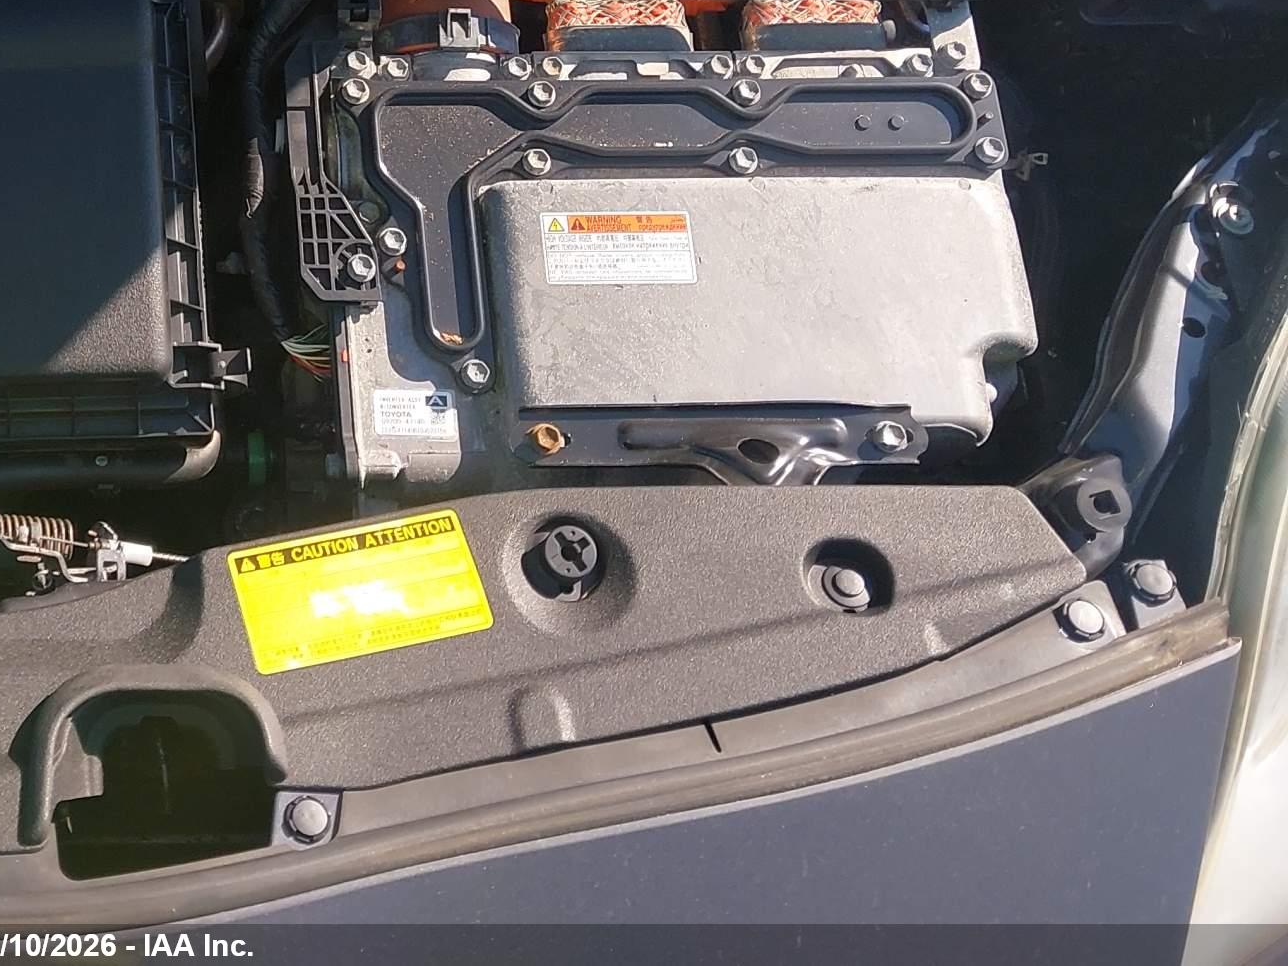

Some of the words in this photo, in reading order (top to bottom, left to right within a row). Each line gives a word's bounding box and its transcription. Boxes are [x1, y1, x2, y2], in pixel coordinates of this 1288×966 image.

[585, 216, 622, 224] WARNING
[291, 537, 359, 562] CAUTION
[365, 517, 453, 549] ATTENTION
